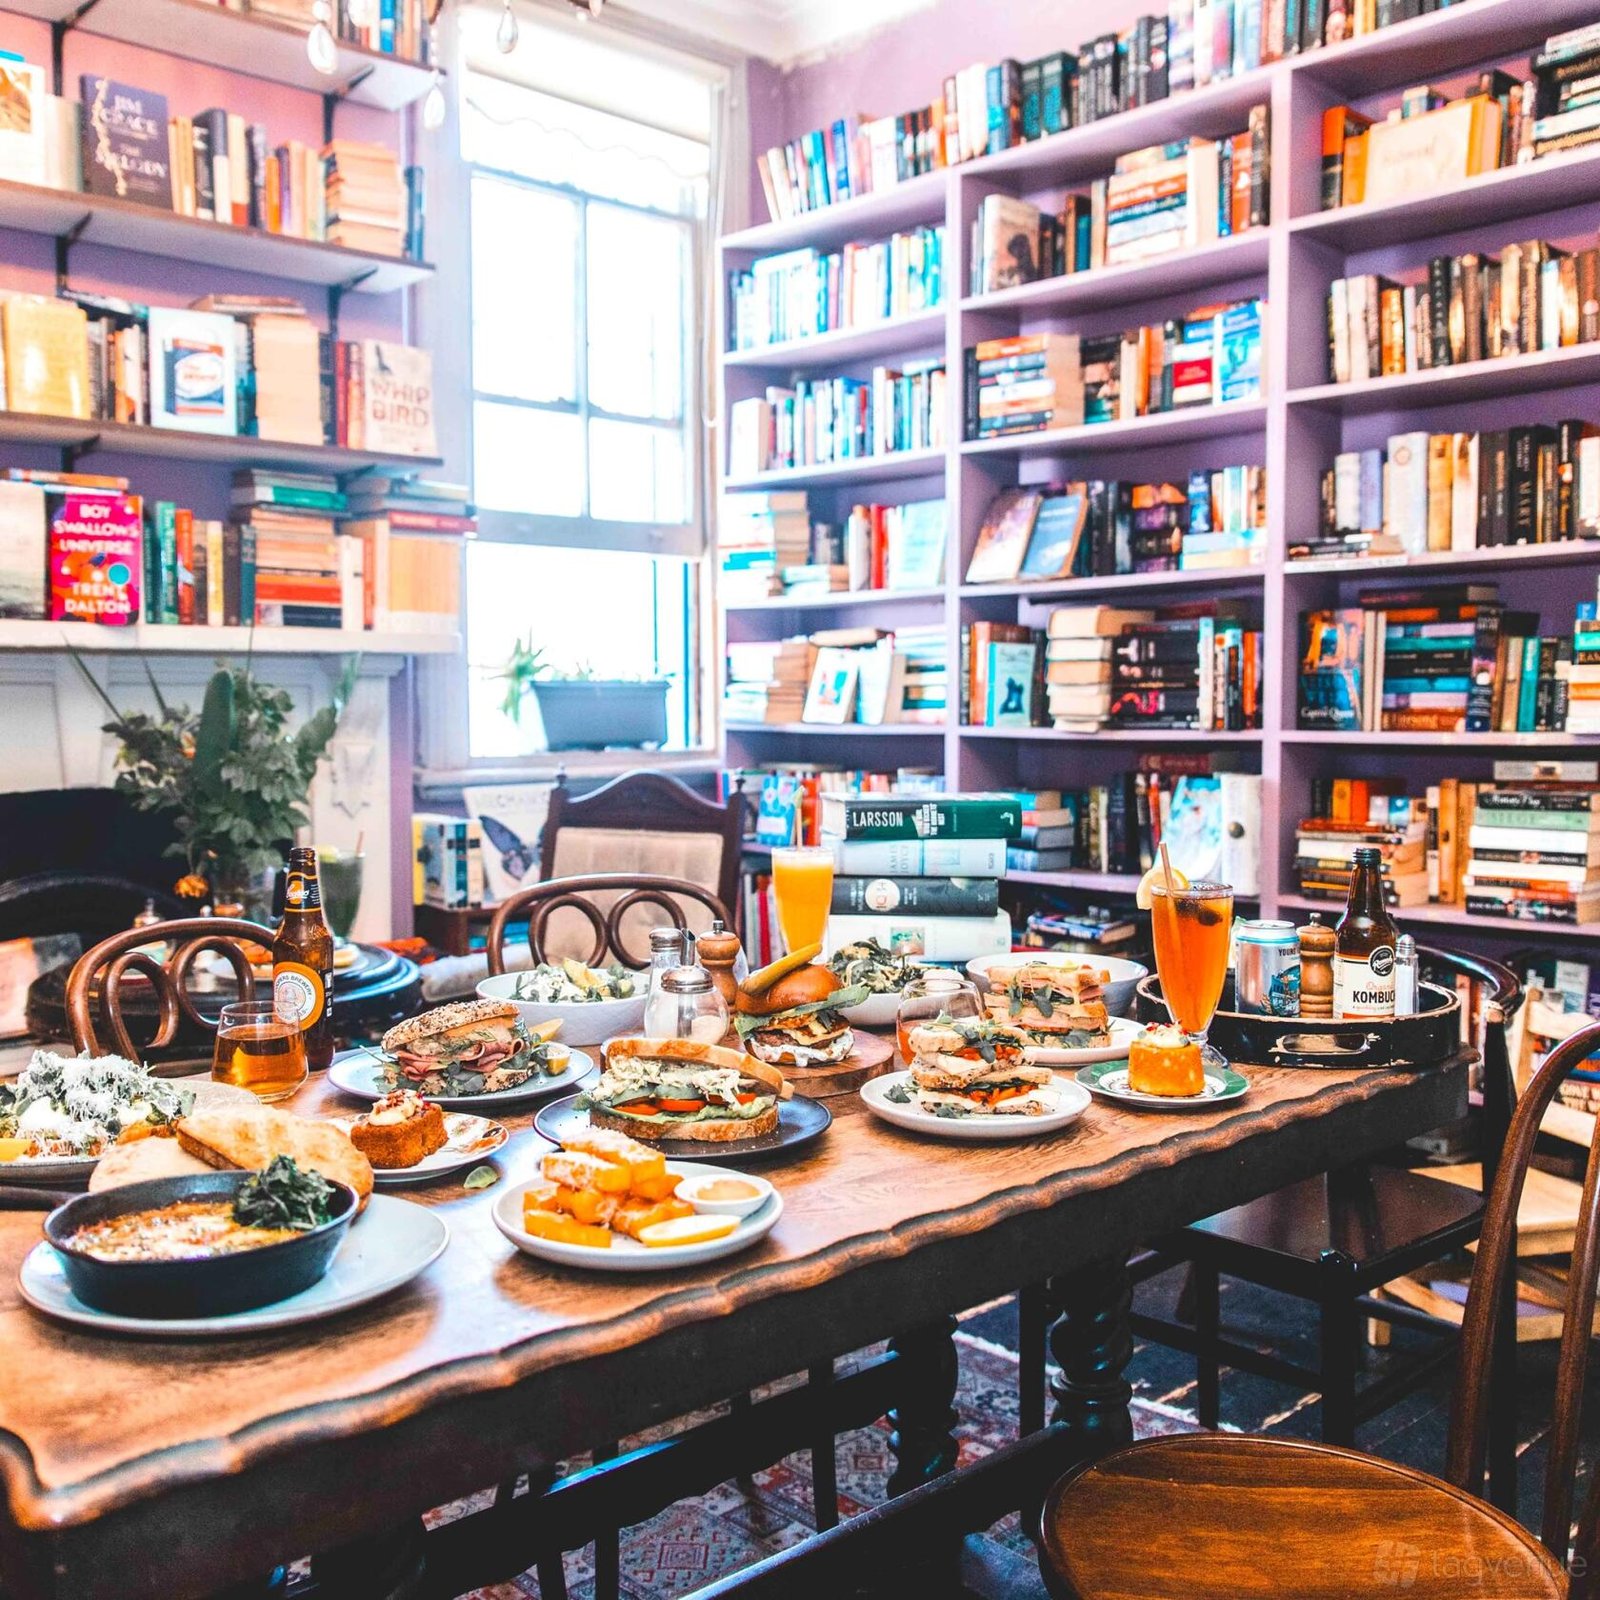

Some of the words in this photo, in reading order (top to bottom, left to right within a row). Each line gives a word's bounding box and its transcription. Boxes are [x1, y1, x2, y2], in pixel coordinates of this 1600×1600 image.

[371, 377, 430, 404] WHIP
[372, 399, 430, 427] BIRD
[79, 503, 111, 519] BOY
[53, 519, 140, 538] SWALLOWS
[59, 538, 135, 556] UNIVERSE
[64, 598, 132, 614] DALTON
[852, 811, 903, 828] LARSSON
[1352, 990, 1396, 1004] KOMBUC
